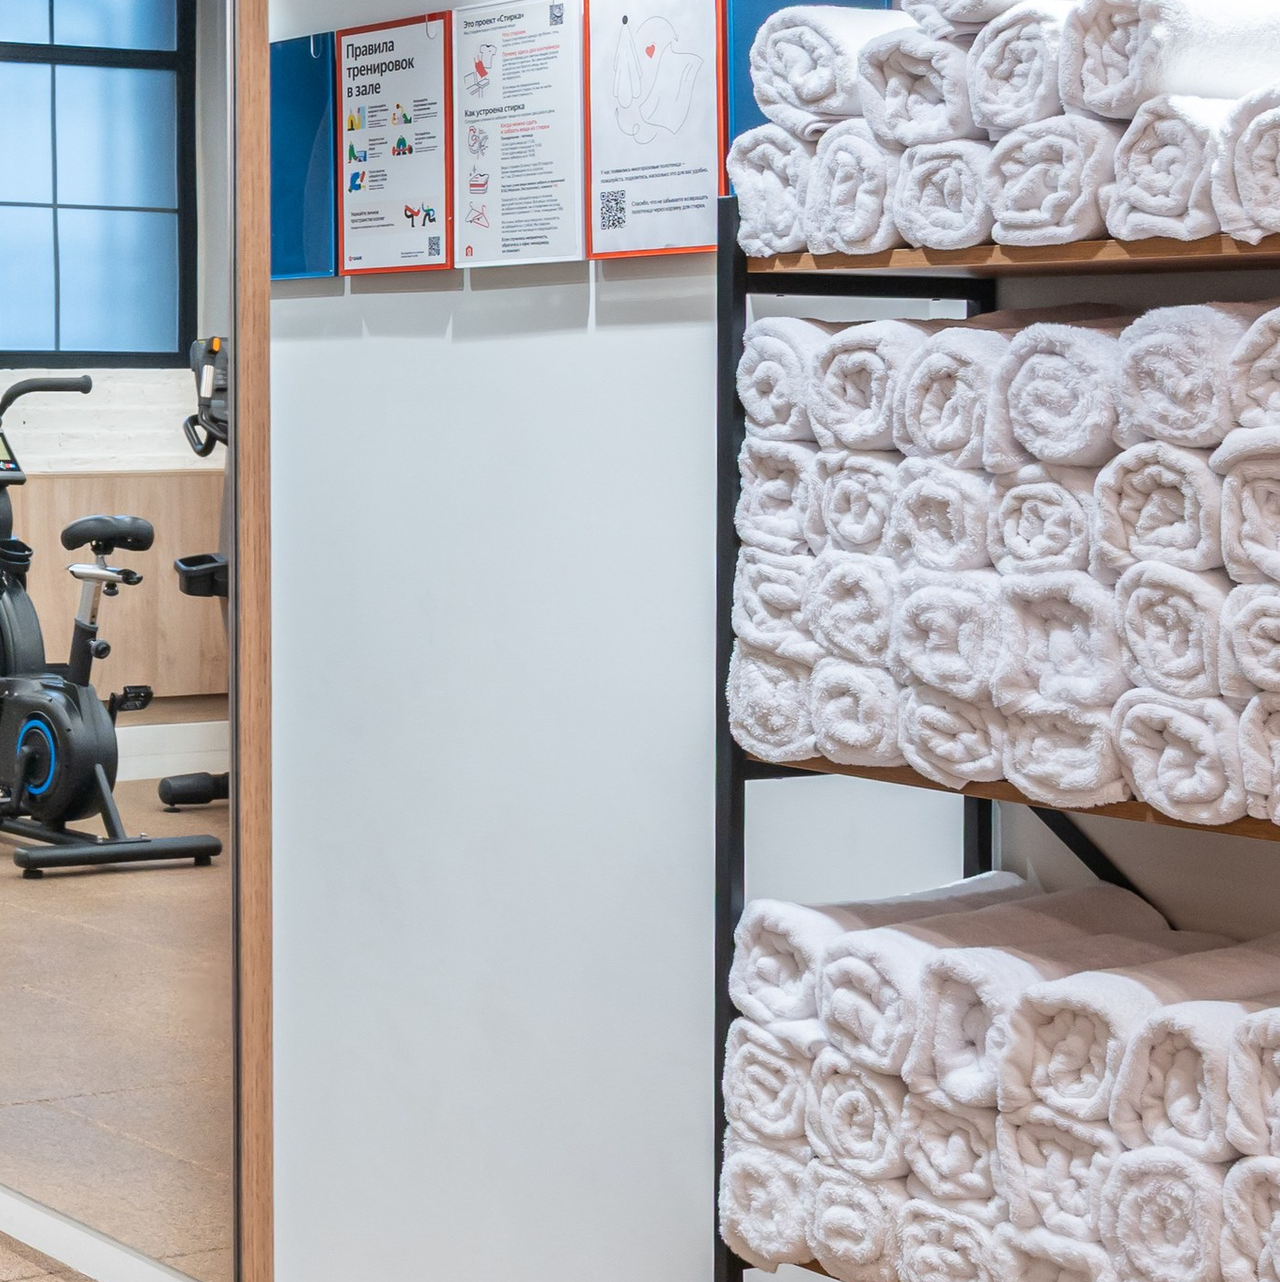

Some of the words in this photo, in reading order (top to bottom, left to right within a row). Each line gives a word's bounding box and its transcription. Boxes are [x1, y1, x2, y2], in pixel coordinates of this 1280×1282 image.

[464, 20, 475, 29] Это
[475, 18, 496, 28] проект
[497, 13, 524, 23] «Стирка»
[346, 40, 395, 61] Правила
[346, 57, 415, 81] тренировок
[347, 86, 353, 98] в
[355, 82, 381, 97] зале
[464, 109, 475, 117] Как
[475, 106, 503, 118] устроена
[504, 103, 525, 113] стирка
